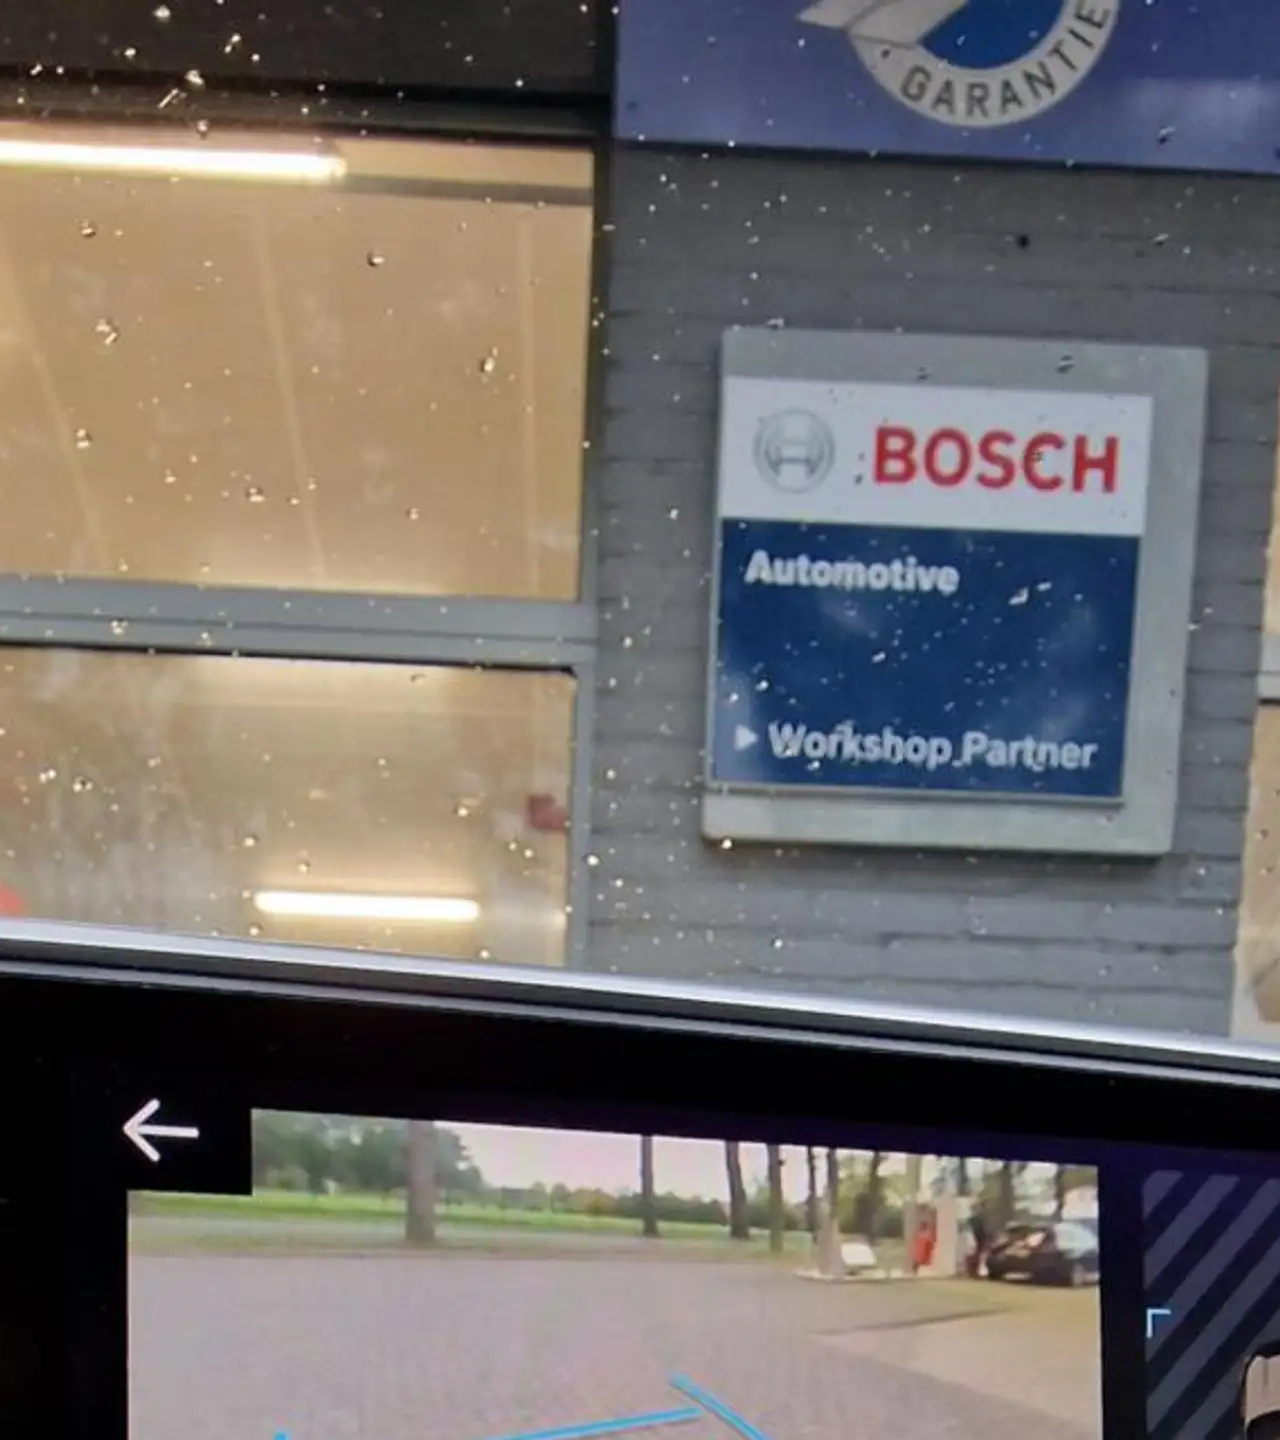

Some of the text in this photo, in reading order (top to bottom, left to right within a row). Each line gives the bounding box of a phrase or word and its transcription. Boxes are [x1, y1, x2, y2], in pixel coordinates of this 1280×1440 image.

[900, 0, 1111, 117] GARANTIE
[872, 426, 1119, 493] BOSCH
[744, 549, 960, 596] Automotive
[769, 721, 1098, 772] Workshop Partner
